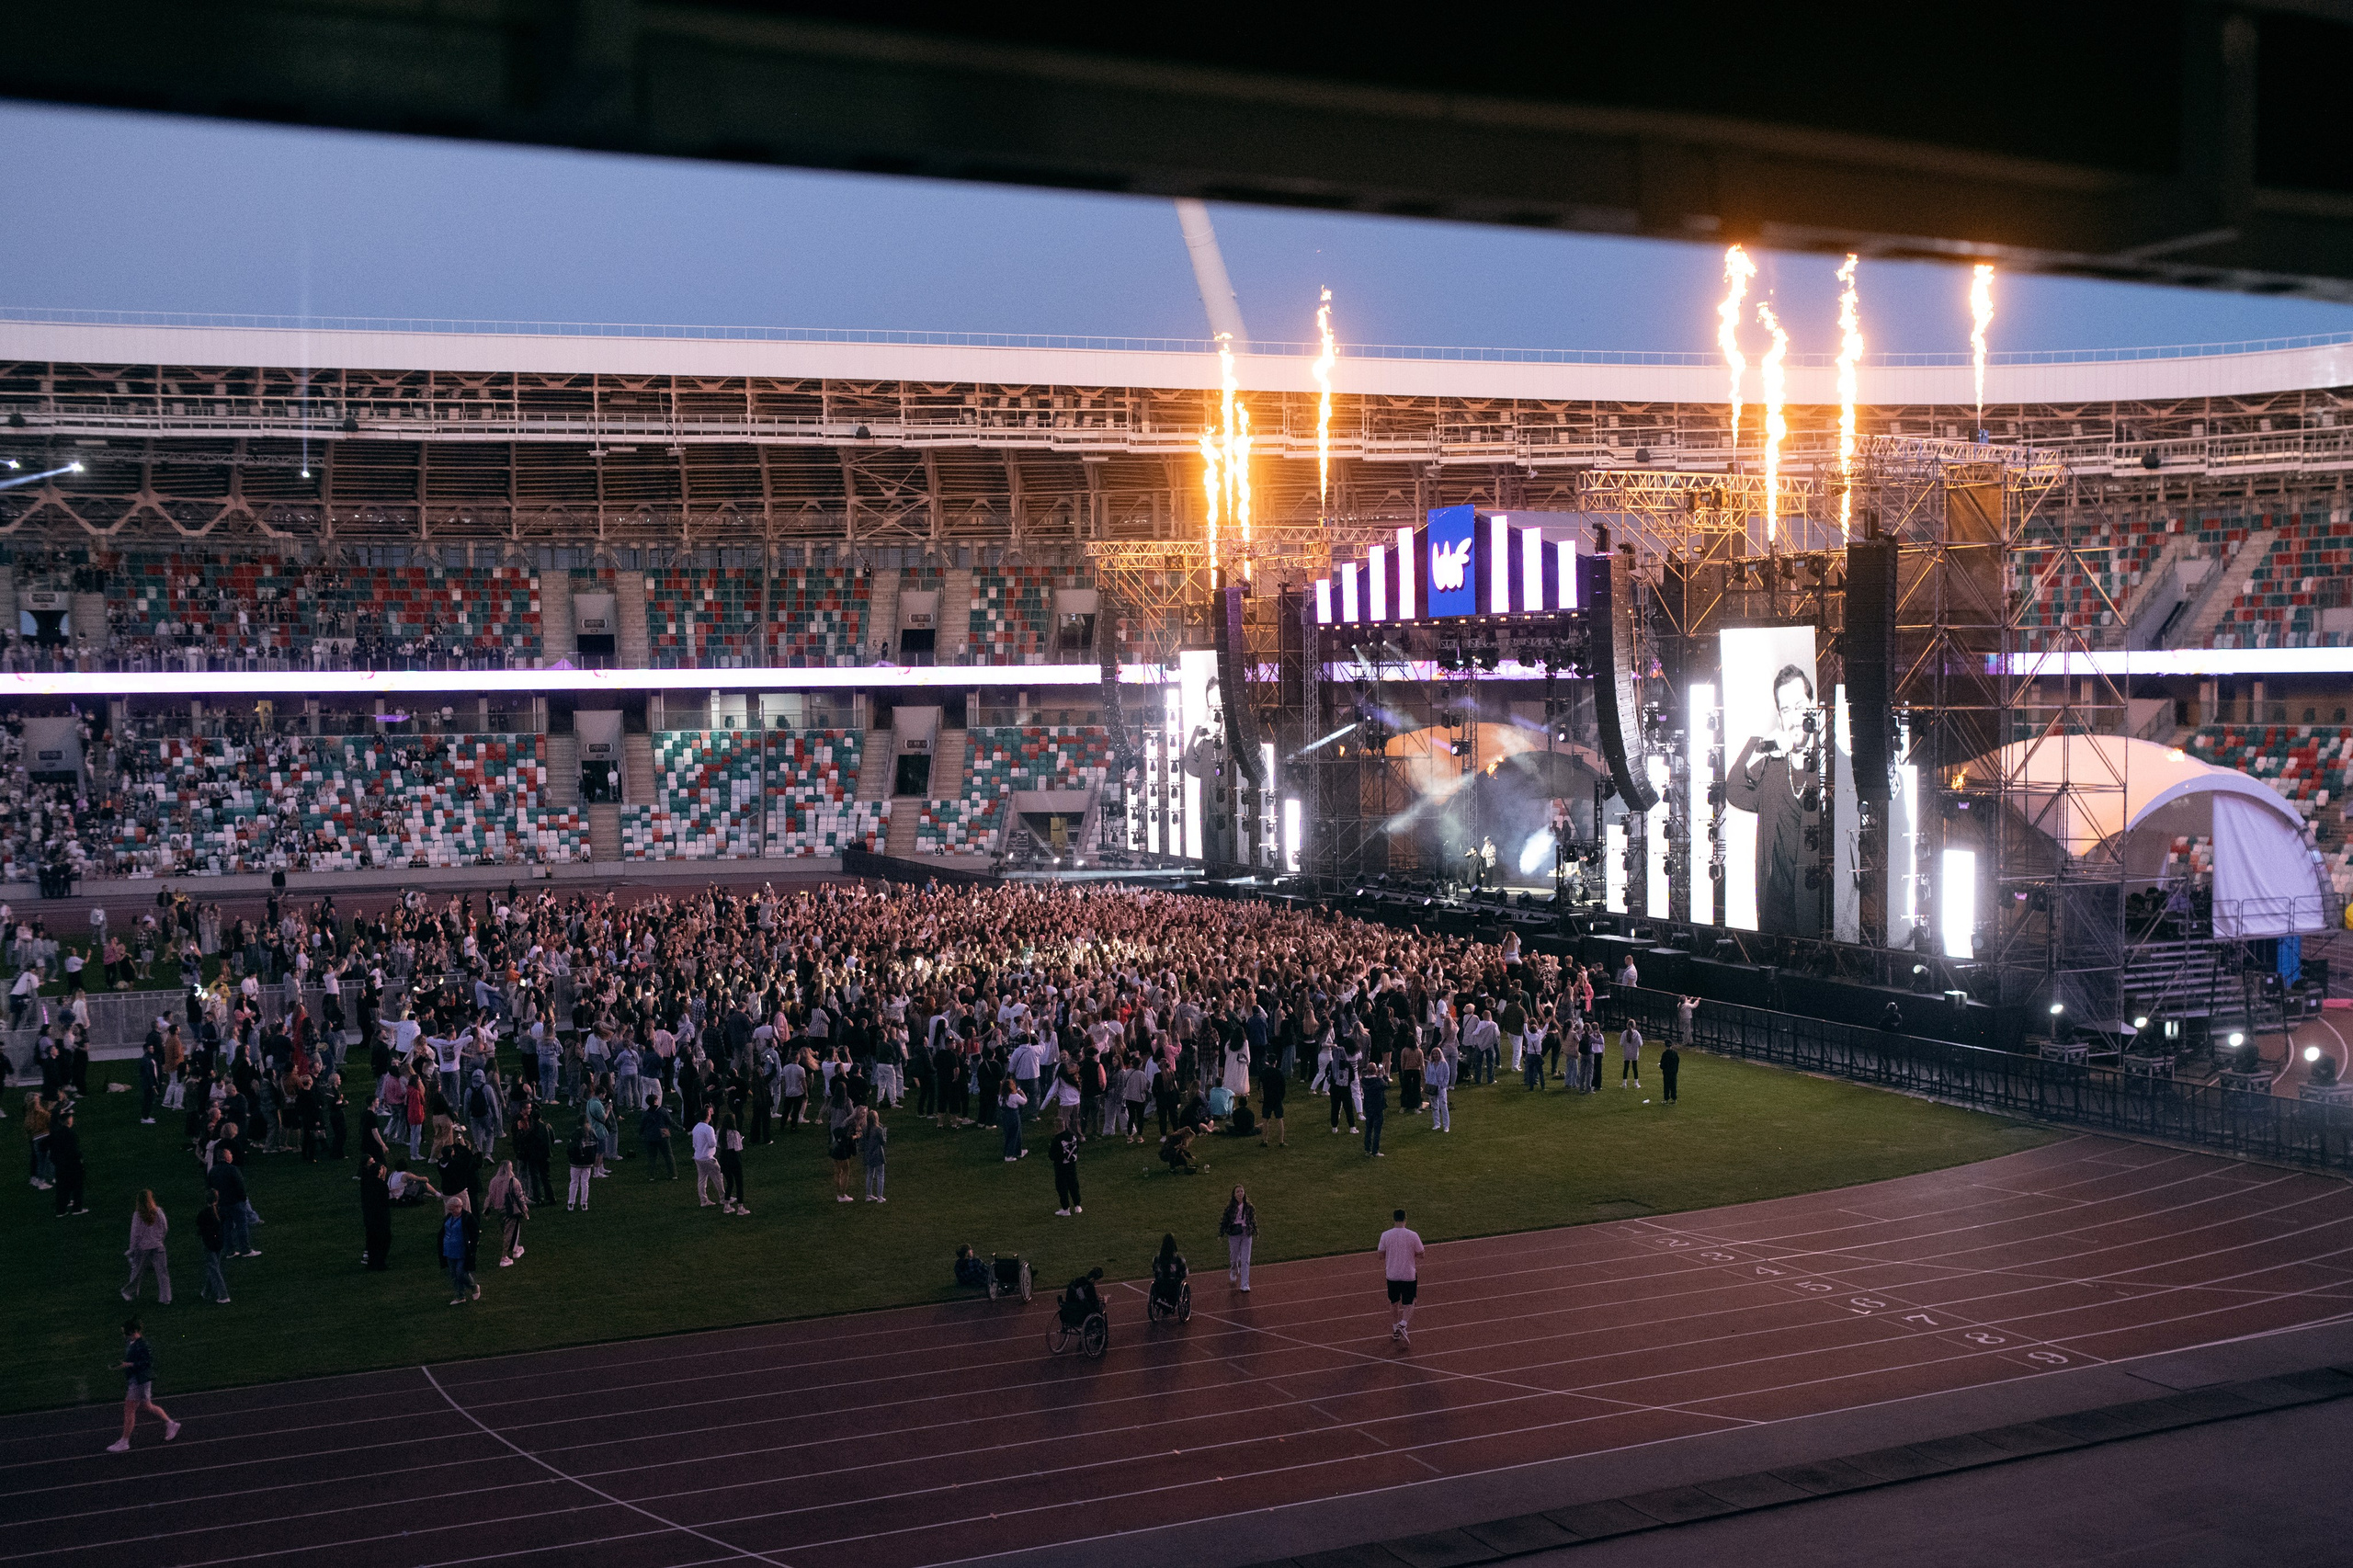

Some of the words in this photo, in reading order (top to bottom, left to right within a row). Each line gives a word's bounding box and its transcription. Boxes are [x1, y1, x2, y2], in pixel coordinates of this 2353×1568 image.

[1655, 1238, 1689, 1247] 2
[1700, 1252, 1734, 1261] 3
[1756, 1266, 1786, 1276] 4
[1795, 1280, 1833, 1292] 5
[1850, 1297, 1886, 1308] 6
[1901, 1313, 1938, 1325] 7
[1964, 1332, 2006, 1345] 8
[2028, 1351, 2069, 1364] 9
